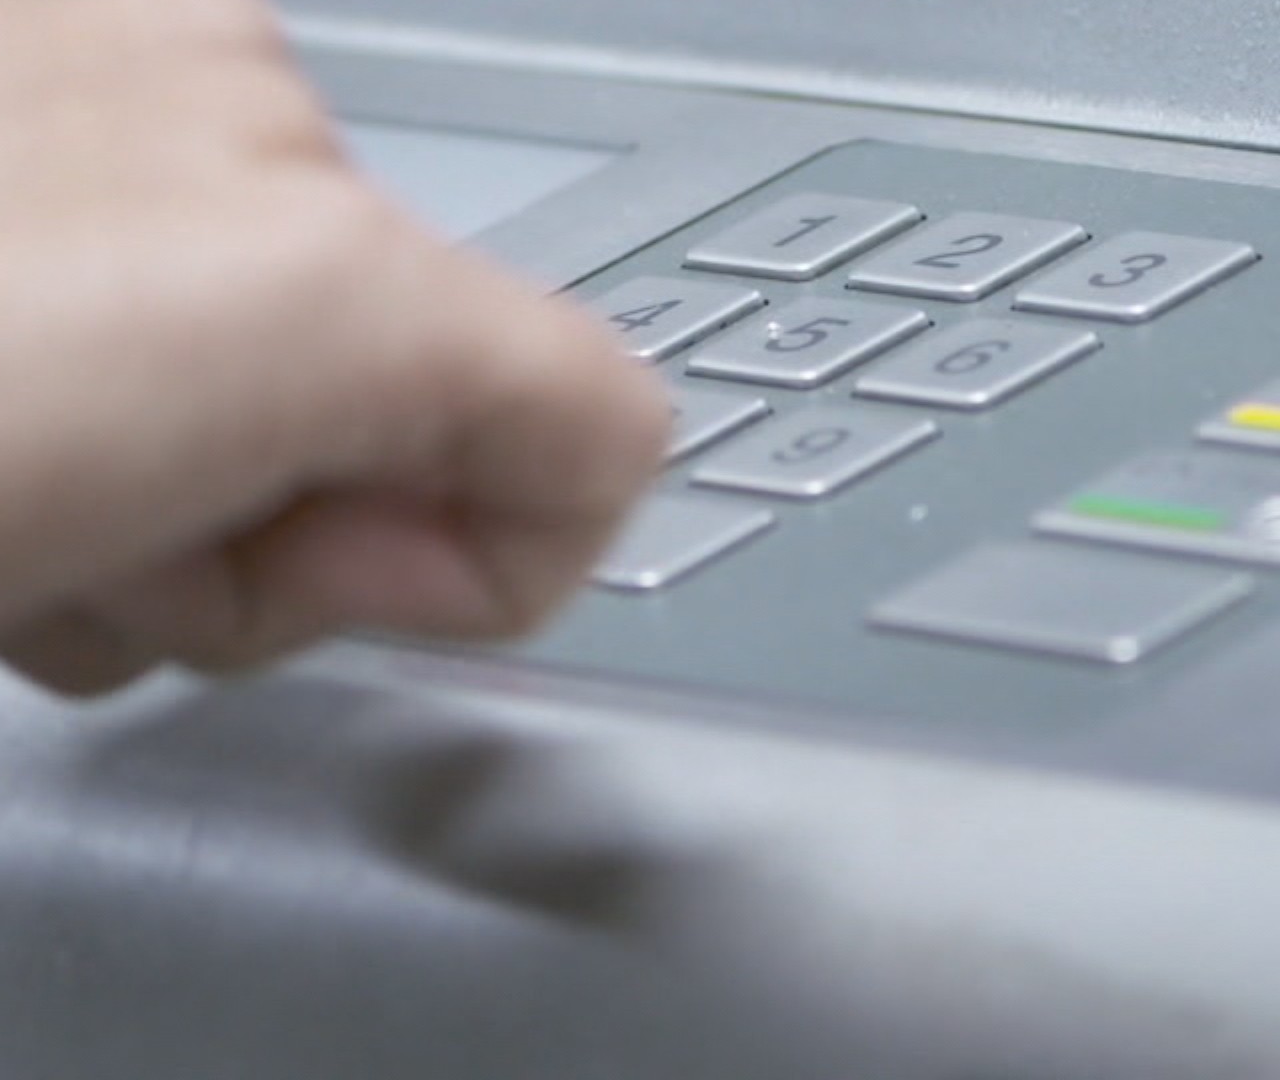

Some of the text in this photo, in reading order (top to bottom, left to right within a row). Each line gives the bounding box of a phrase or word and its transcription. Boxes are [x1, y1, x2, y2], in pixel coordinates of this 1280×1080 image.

[773, 214, 839, 248] 1
[912, 232, 1004, 269] 2
[1086, 252, 1168, 289] 3
[607, 298, 684, 332] 4
[764, 316, 851, 353] 5
[933, 339, 1011, 376] 6
[772, 426, 851, 465] 9
